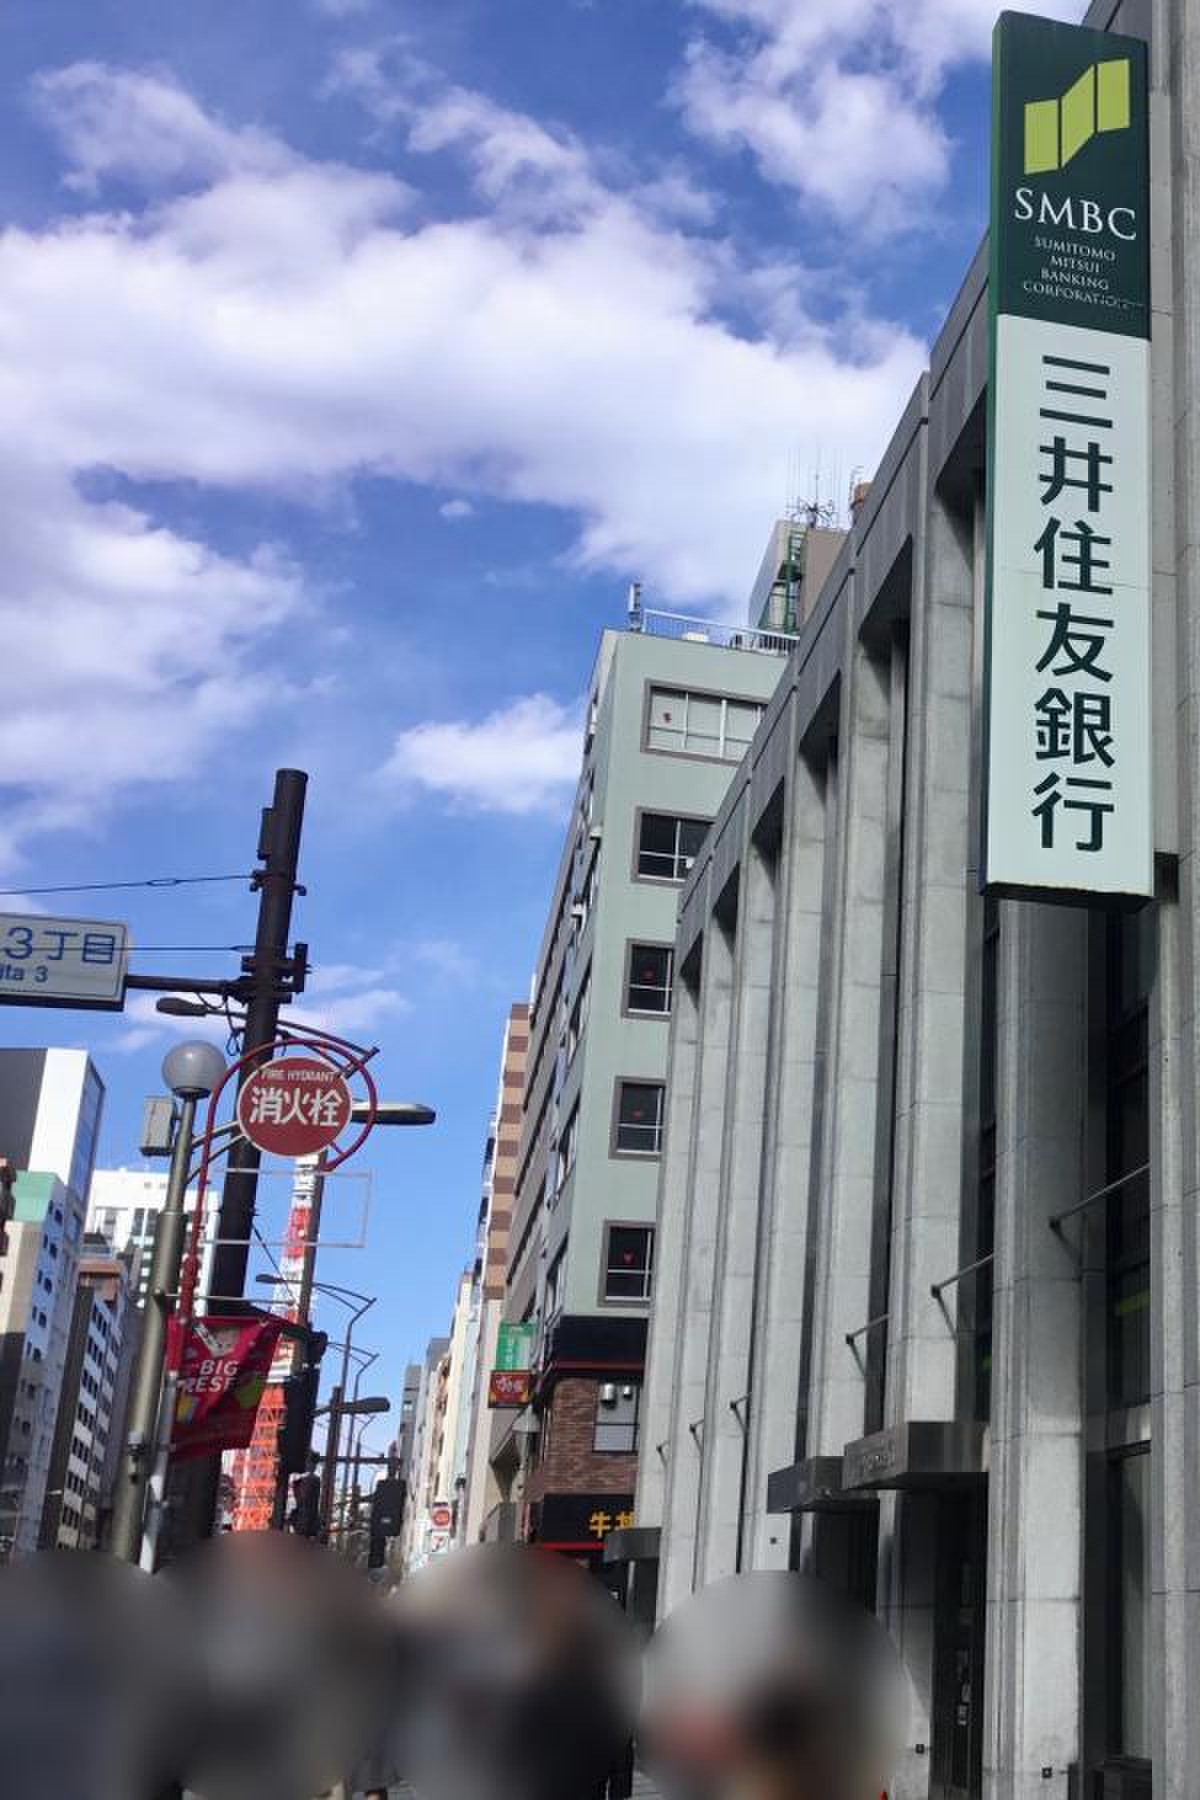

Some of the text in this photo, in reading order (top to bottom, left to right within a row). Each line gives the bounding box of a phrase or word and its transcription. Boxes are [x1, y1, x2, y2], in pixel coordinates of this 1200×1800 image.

[1014, 187, 1137, 241] SMBC
[1034, 235, 1116, 261] SUMITOMO
[1050, 255, 1101, 273] MITSUI
[1041, 268, 1110, 291] BANKING
[1031, 354, 1115, 852] 三井住友銀行
[4, 926, 116, 964] 3丁目
[35, 965, 49, 983] 3
[250, 1086, 343, 1126] 消火栓
[200, 1359, 241, 1377] BIG
